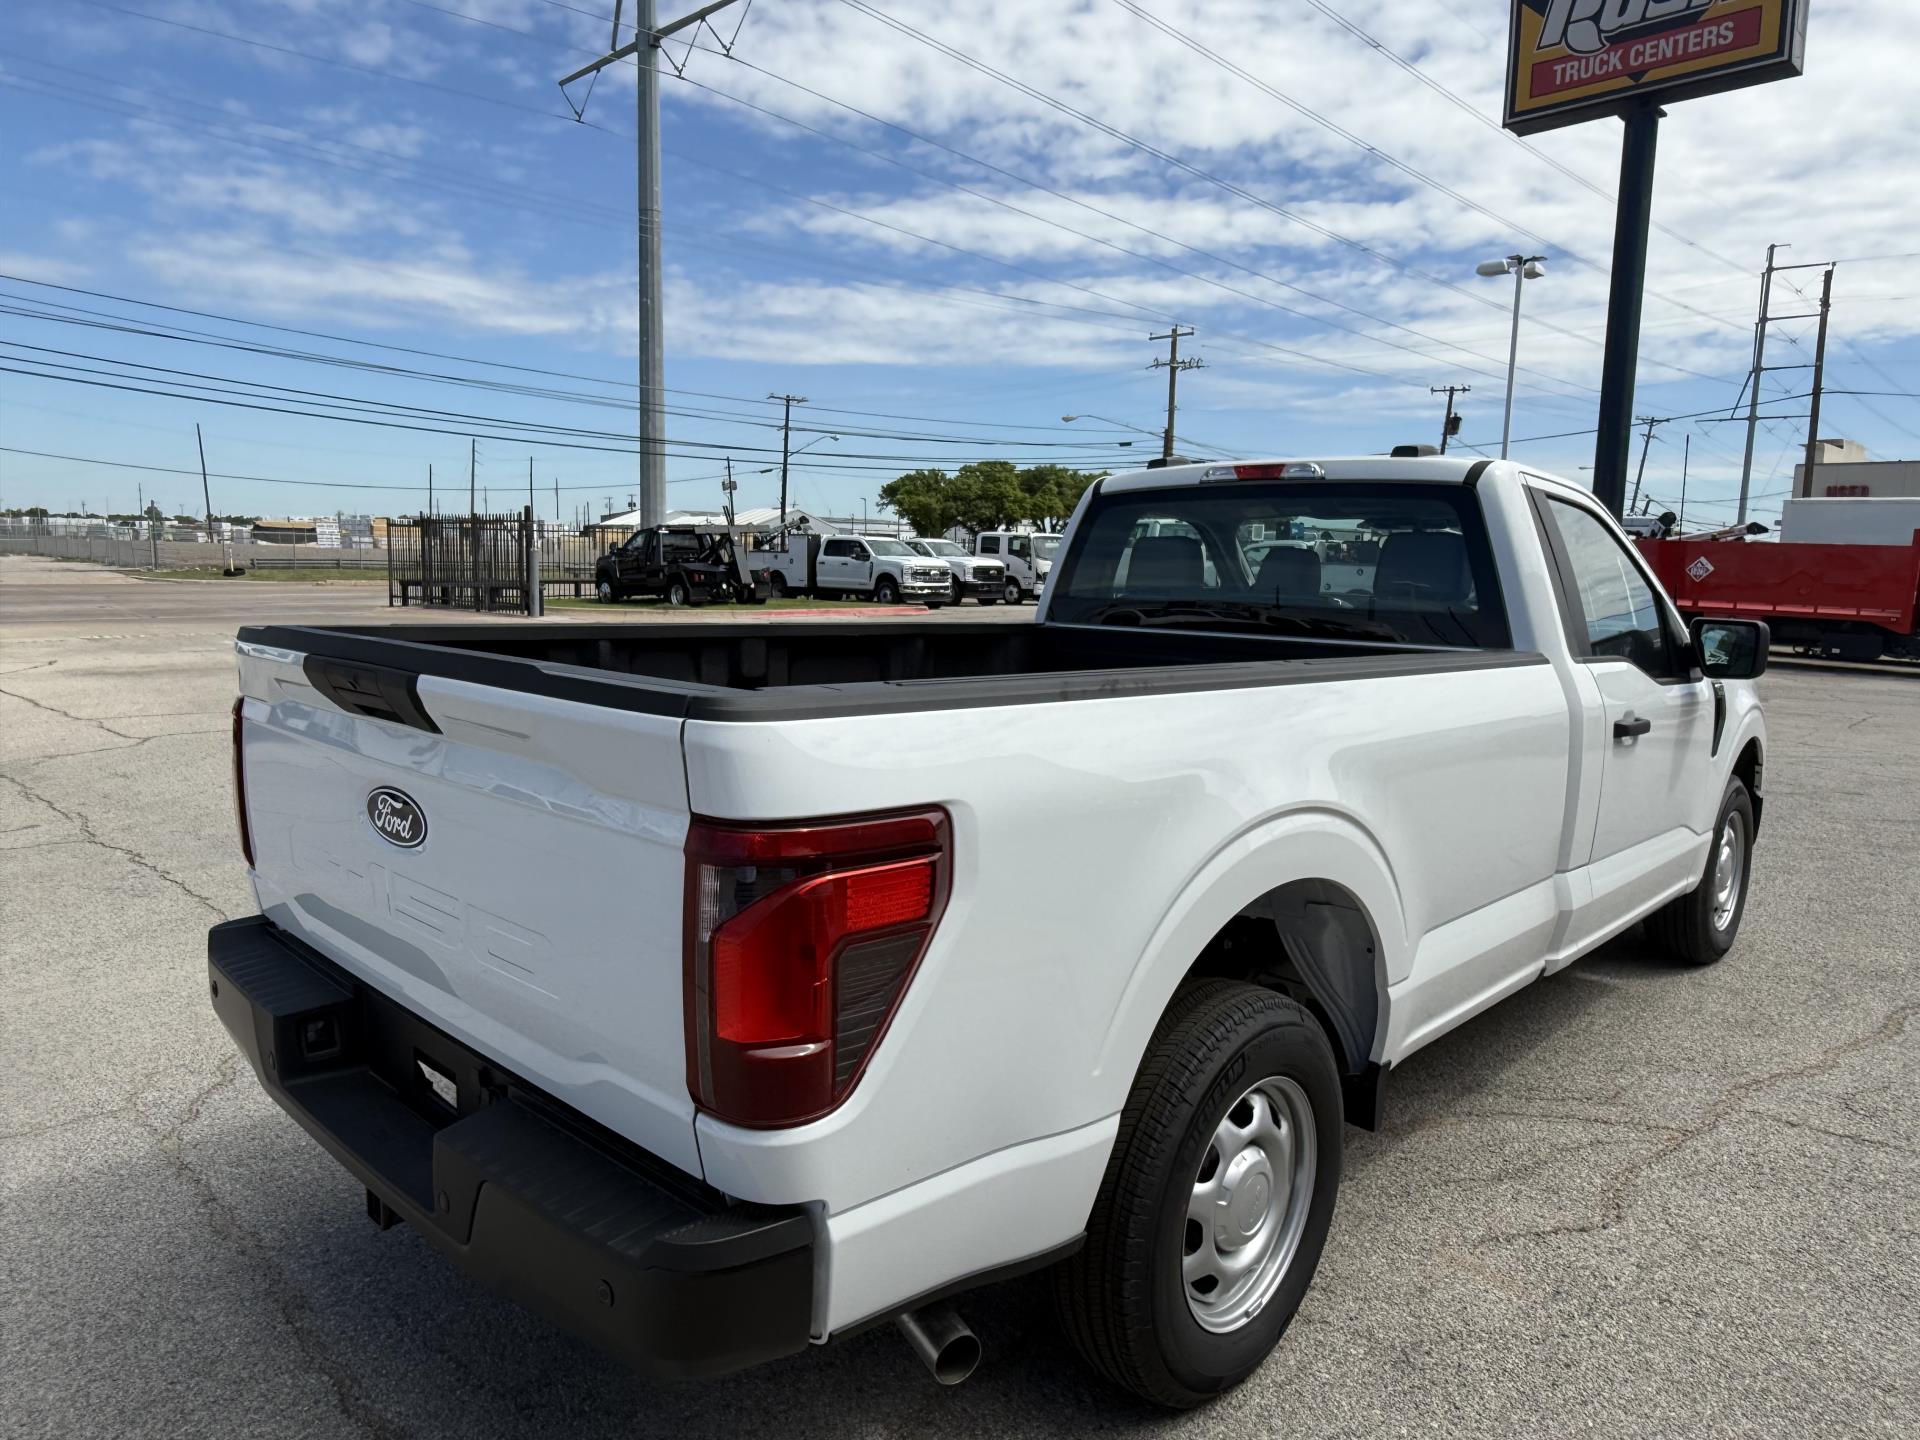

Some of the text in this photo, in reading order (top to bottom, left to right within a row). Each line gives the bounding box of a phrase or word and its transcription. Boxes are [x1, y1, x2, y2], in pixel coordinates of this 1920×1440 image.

[1553, 21, 1734, 85] TRUCK CENTERS
[375, 795, 413, 838] Ford
